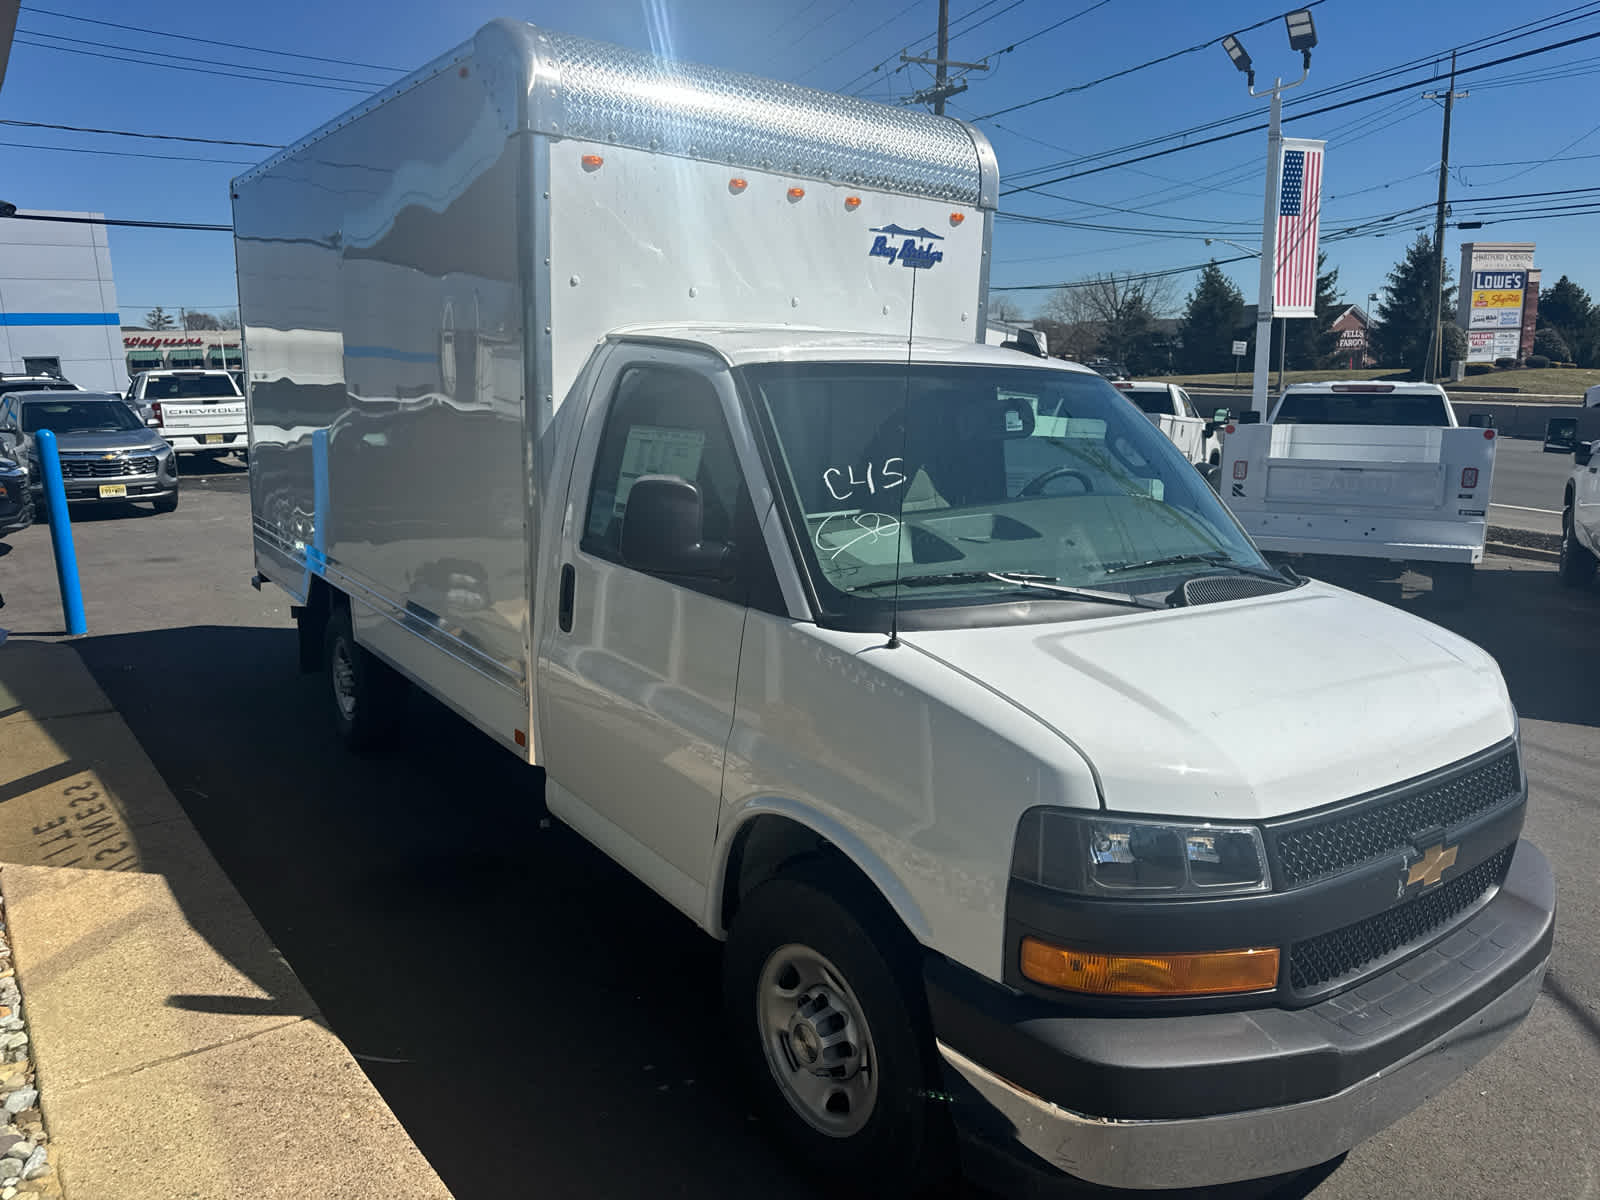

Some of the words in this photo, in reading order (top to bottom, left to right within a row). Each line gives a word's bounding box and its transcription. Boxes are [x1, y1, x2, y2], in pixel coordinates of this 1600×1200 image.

[869, 235, 899, 265] Bay
[1476, 273, 1521, 289] LOWE'S
[123, 336, 204, 352] Walgreens
